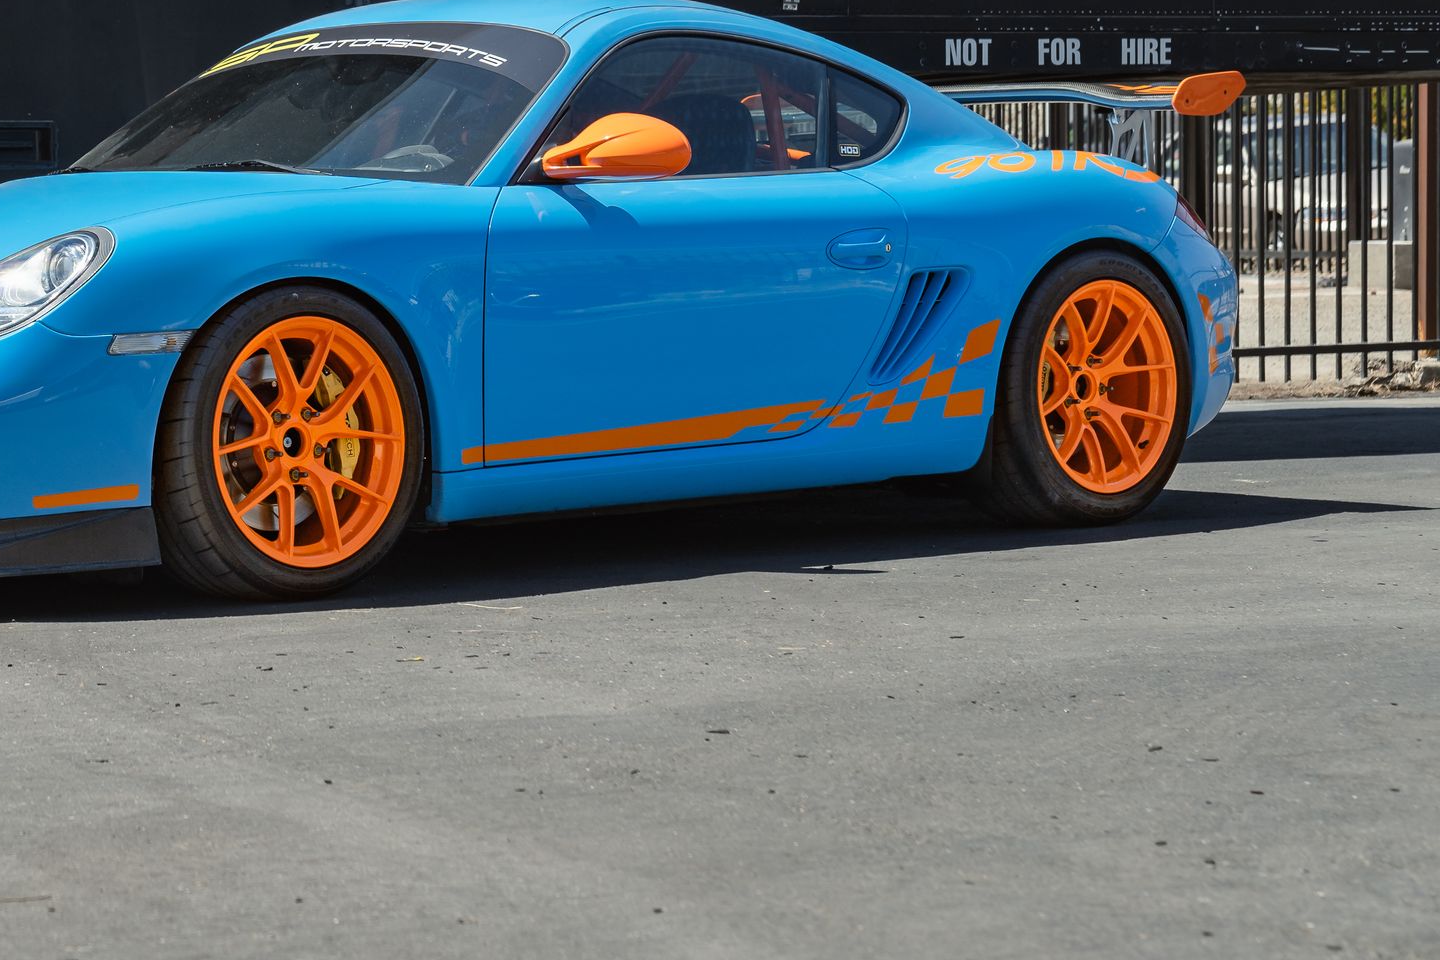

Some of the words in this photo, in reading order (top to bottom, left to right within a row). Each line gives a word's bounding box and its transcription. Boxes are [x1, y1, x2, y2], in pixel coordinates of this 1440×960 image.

[293, 38, 508, 68] MOTORSPORTS
[945, 38, 992, 67] NOT
[1038, 38, 1081, 66] FOR
[1121, 38, 1172, 65] HIRE
